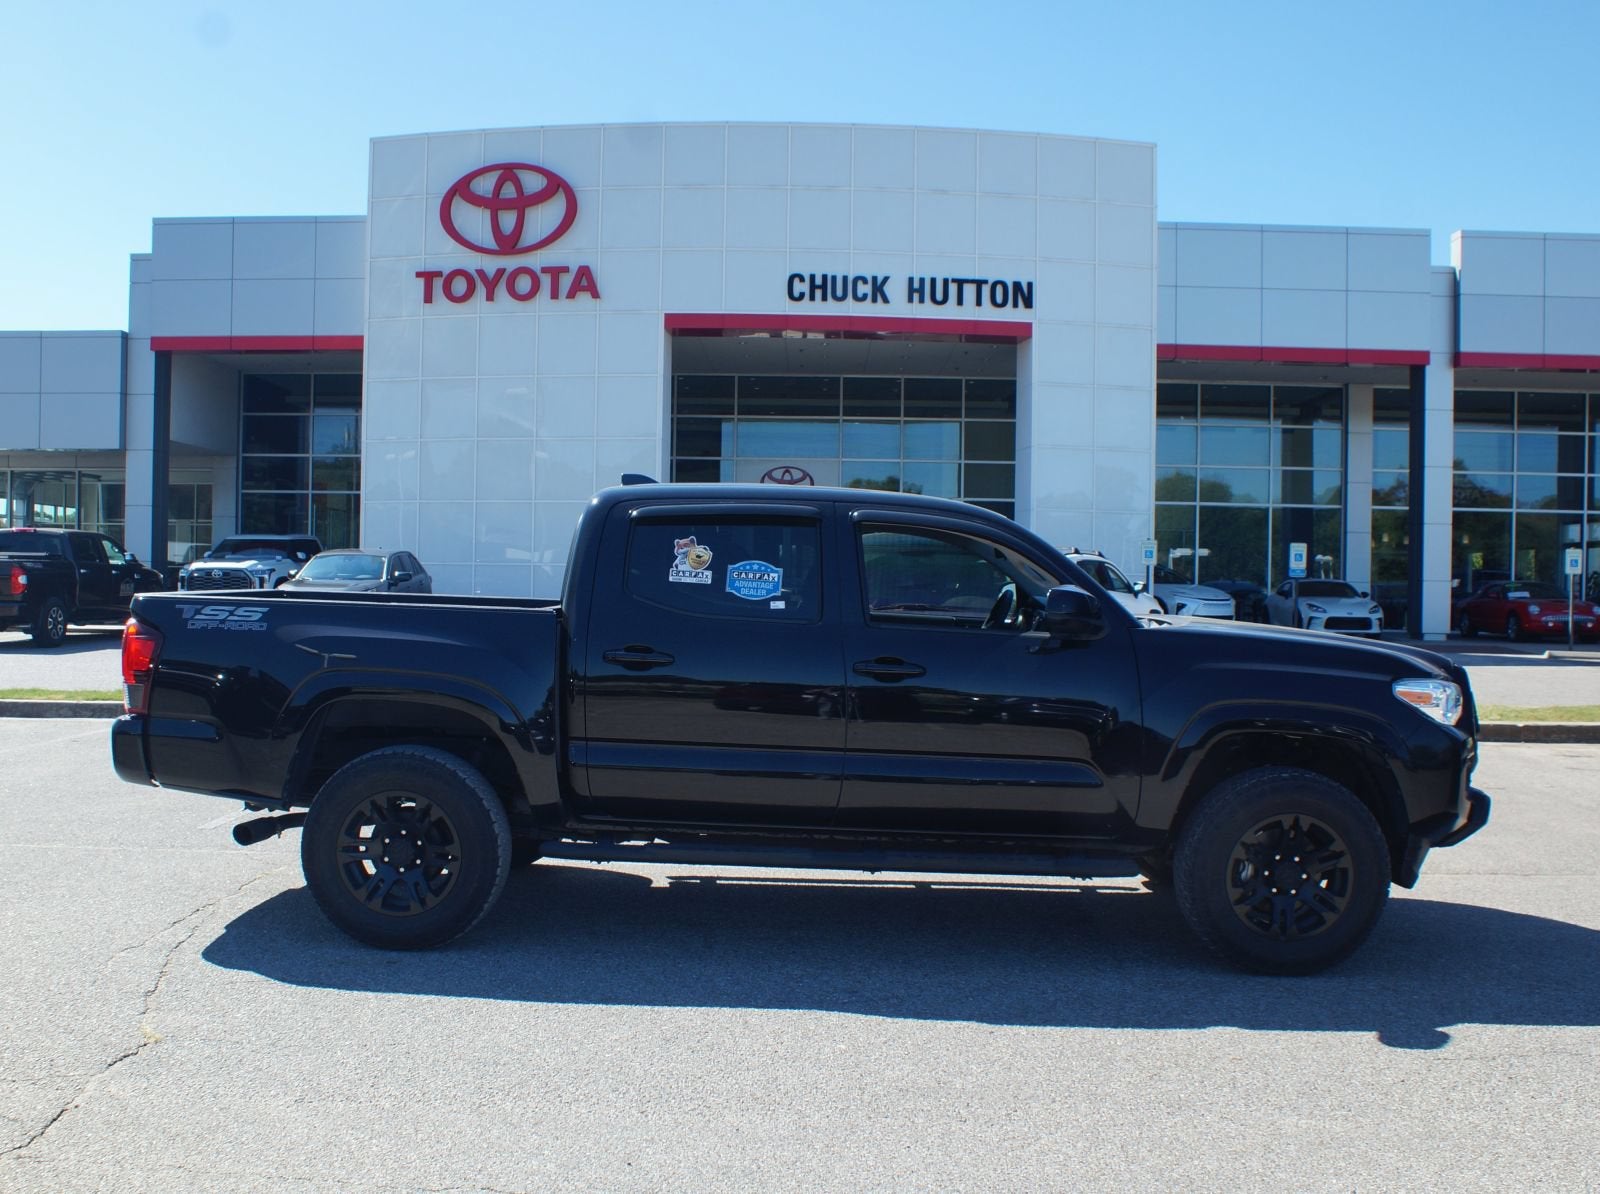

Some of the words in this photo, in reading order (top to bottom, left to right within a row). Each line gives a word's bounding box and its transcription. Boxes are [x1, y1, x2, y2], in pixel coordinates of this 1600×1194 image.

[415, 265, 601, 304] TOYOTA
[787, 273, 890, 304] CHUCK
[907, 276, 1034, 309] HUTTON
[672, 570, 710, 579] CARFAX
[733, 571, 777, 581] CARFAX
[734, 580, 774, 590] ADVANTAGE
[740, 588, 767, 596] DEALER
[187, 621, 267, 631] OFF-ROAD
